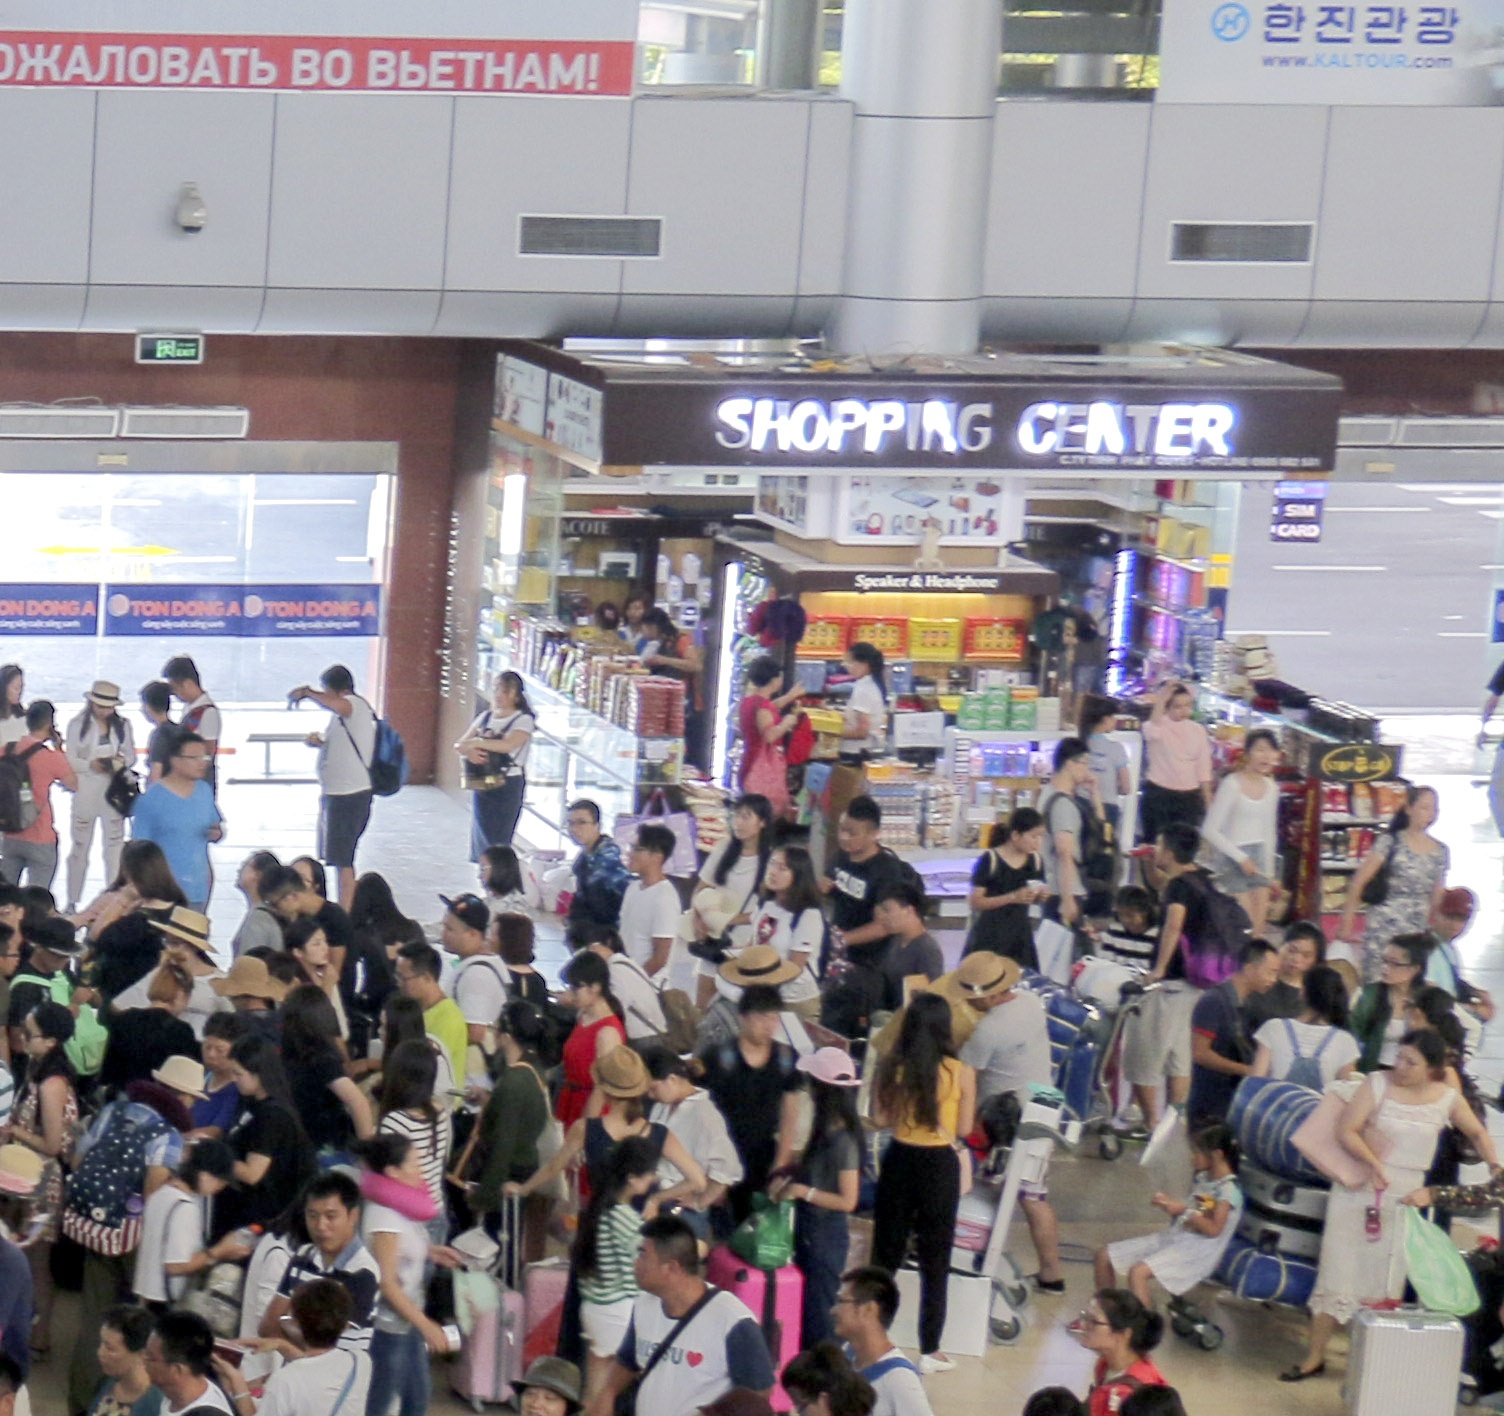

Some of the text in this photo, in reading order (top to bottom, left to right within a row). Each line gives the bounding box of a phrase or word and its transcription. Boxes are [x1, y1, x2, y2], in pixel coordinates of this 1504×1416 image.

[1264, 4, 1459, 44] 한진관광
[293, 46, 355, 88] ВО
[370, 48, 600, 92] ВЬЕТНАМ!
[1262, 53, 1453, 69] www.KALTOUR.com
[715, 399, 1236, 458] SHOPPING CENTER
[1283, 503, 1316, 518] SIM
[1276, 523, 1321, 539] CARD
[854, 574, 909, 590] Speaker
[924, 574, 999, 591] Headphone
